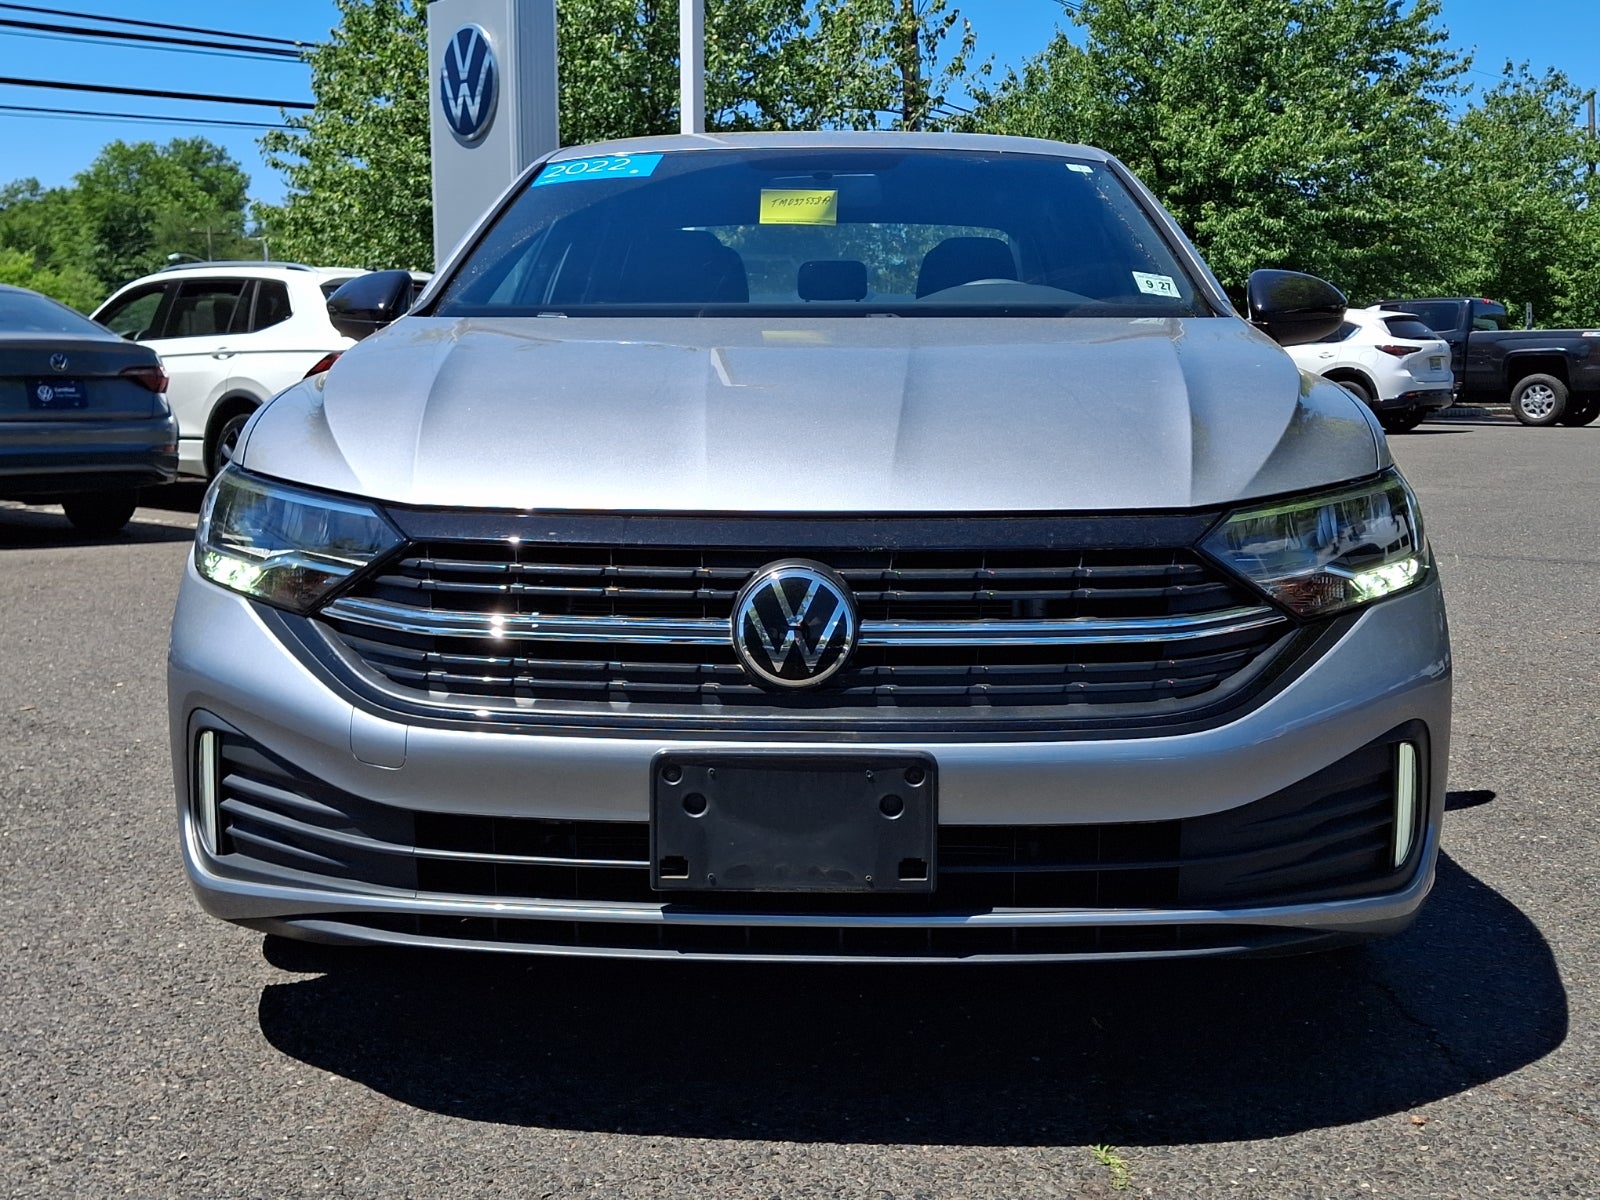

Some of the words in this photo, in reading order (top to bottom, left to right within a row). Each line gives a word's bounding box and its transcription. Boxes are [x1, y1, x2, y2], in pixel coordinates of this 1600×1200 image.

[441, 25, 496, 131] VW
[1145, 279, 1154, 289] 9
[1158, 281, 1171, 291] 27
[742, 573, 849, 675] VW
